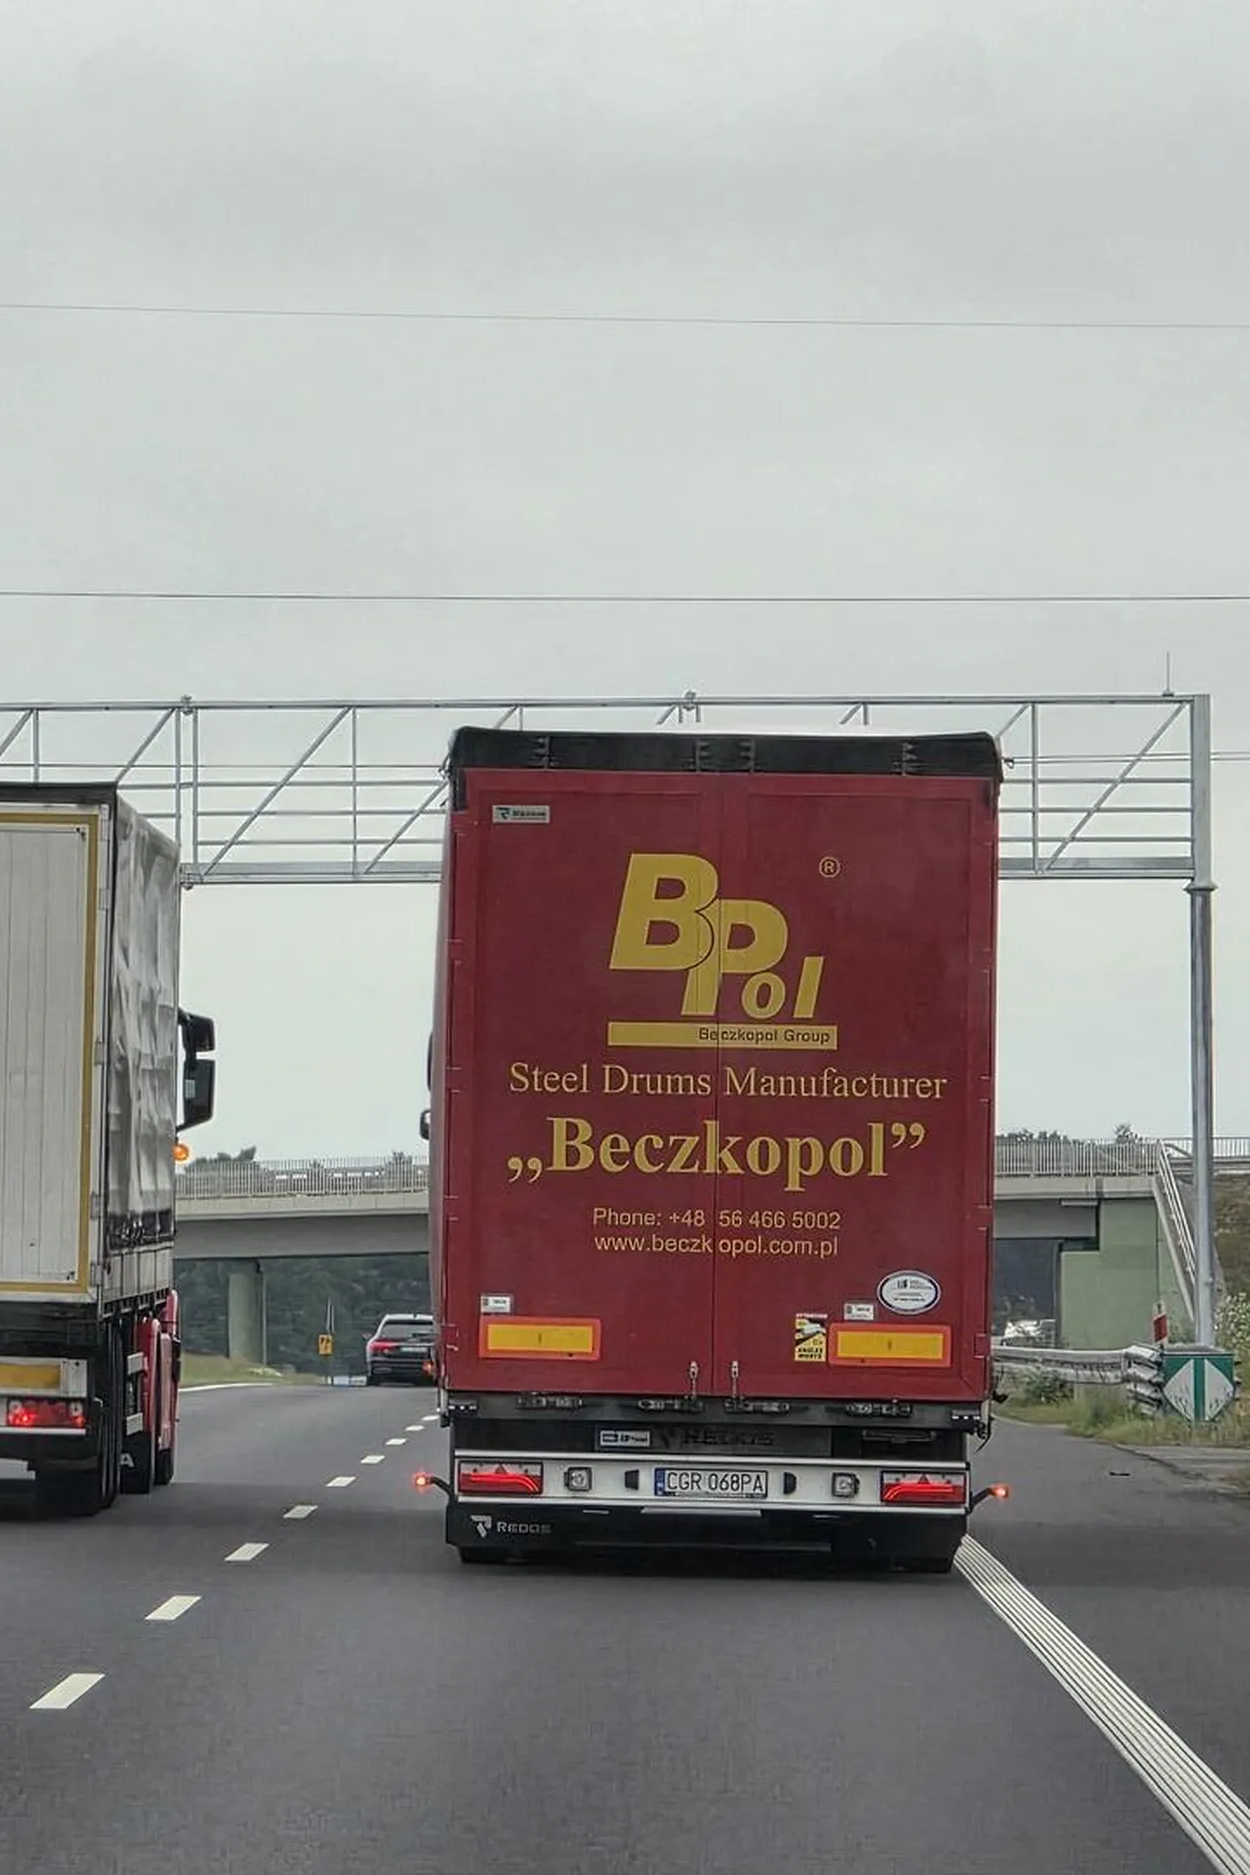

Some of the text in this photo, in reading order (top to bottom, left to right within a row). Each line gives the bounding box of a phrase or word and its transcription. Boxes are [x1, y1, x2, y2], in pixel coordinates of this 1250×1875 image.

[698, 1027, 831, 1046] Beczkopol Group
[509, 1062, 948, 1098] Steel Drums Manufacturer
[593, 1207, 841, 1229] Phone: +48 56 466 5002
[667, 1472, 764, 1492] CGR 068PA
